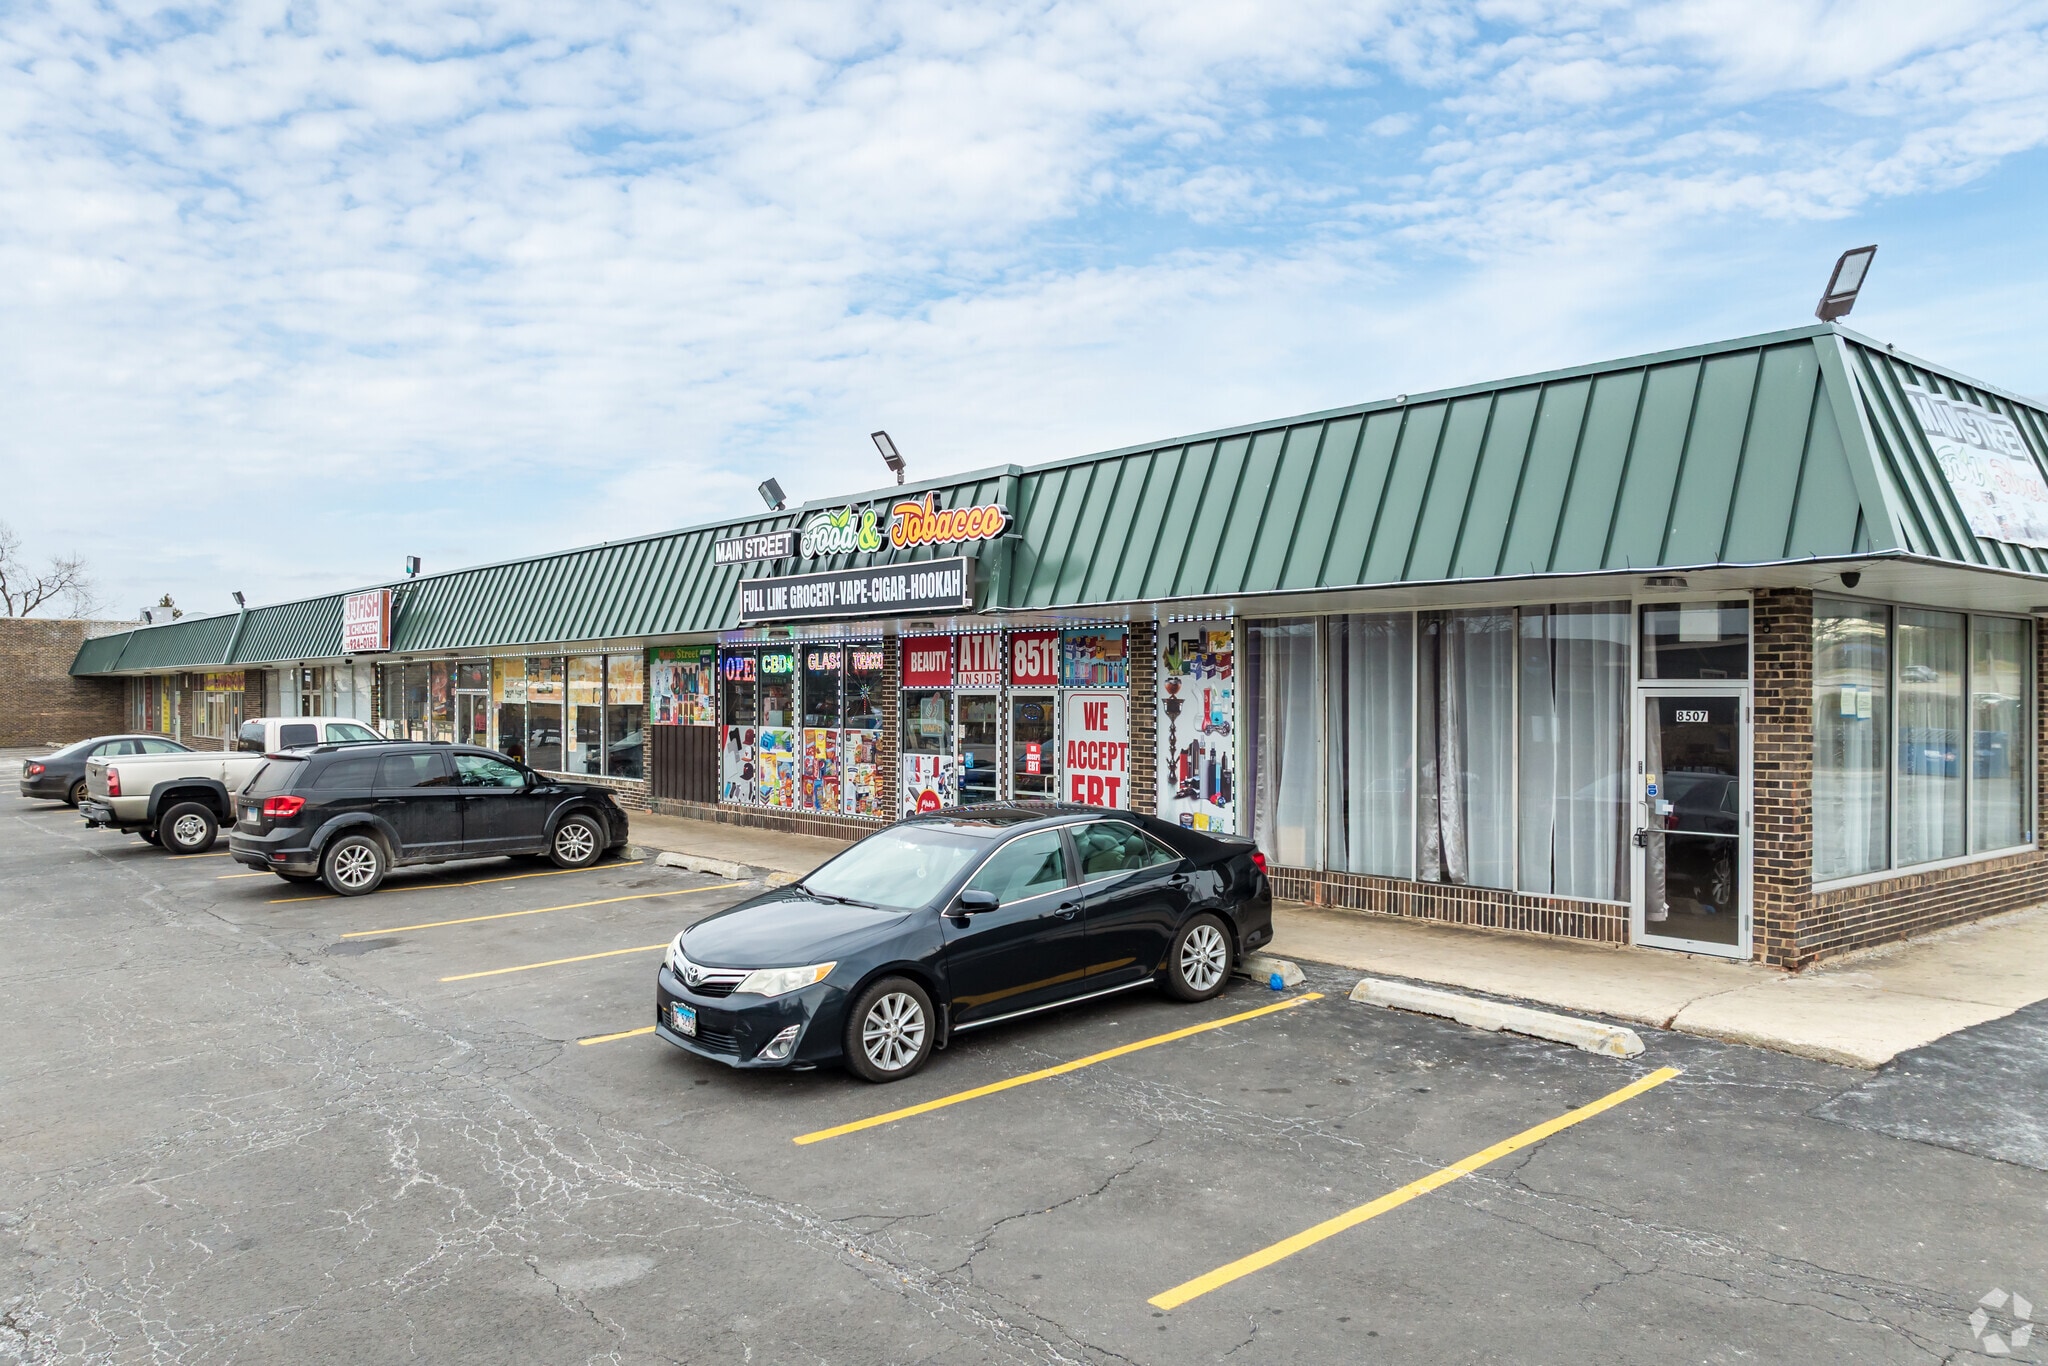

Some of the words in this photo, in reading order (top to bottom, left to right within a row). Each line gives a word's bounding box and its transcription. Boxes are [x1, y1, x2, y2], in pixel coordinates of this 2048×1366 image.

[802, 508, 858, 558] Food
[858, 508, 881, 551] &
[890, 490, 1005, 550] Tobacco
[715, 540, 744, 563] MAIN
[745, 532, 792, 559] STREET
[359, 593, 379, 618] FISH
[743, 589, 765, 613] FULL
[767, 587, 788, 611] LINE
[352, 621, 378, 635] CHICKEN
[676, 648, 699, 660] Street
[762, 655, 787, 673] CBD
[852, 652, 884, 669] TOBACCO
[910, 651, 948, 672] BEAUTY
[960, 635, 1000, 670] ATM
[1014, 638, 1058, 677] 8511
[726, 657, 756, 681] OPE
[961, 673, 1000, 685] INSIDE
[1083, 702, 1109, 731] WE
[1677, 711, 1707, 722] 8507
[1067, 740, 1128, 772] ACCEPT
